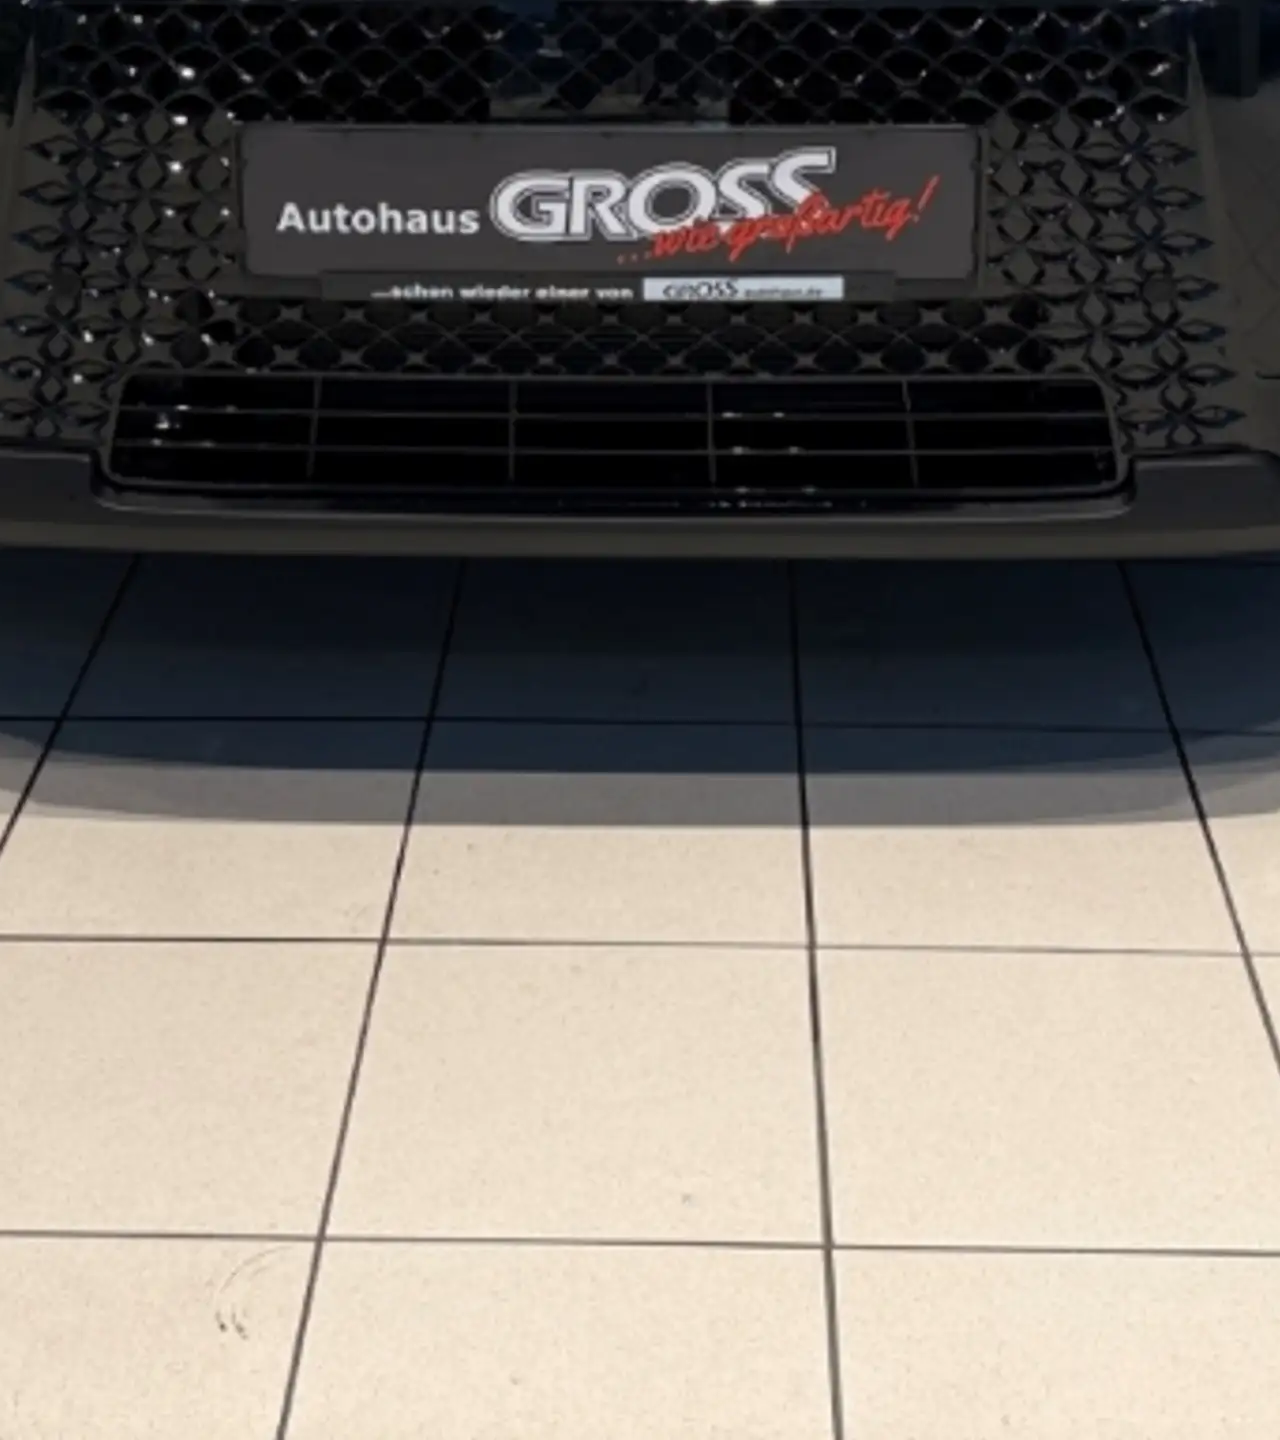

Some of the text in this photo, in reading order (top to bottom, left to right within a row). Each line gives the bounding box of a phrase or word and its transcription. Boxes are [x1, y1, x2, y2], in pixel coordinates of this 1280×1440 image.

[276, 146, 836, 242] Autohaus GROSS
[723, 175, 940, 262] großartig!
[459, 284, 530, 299] wieder
[595, 287, 634, 299] von
